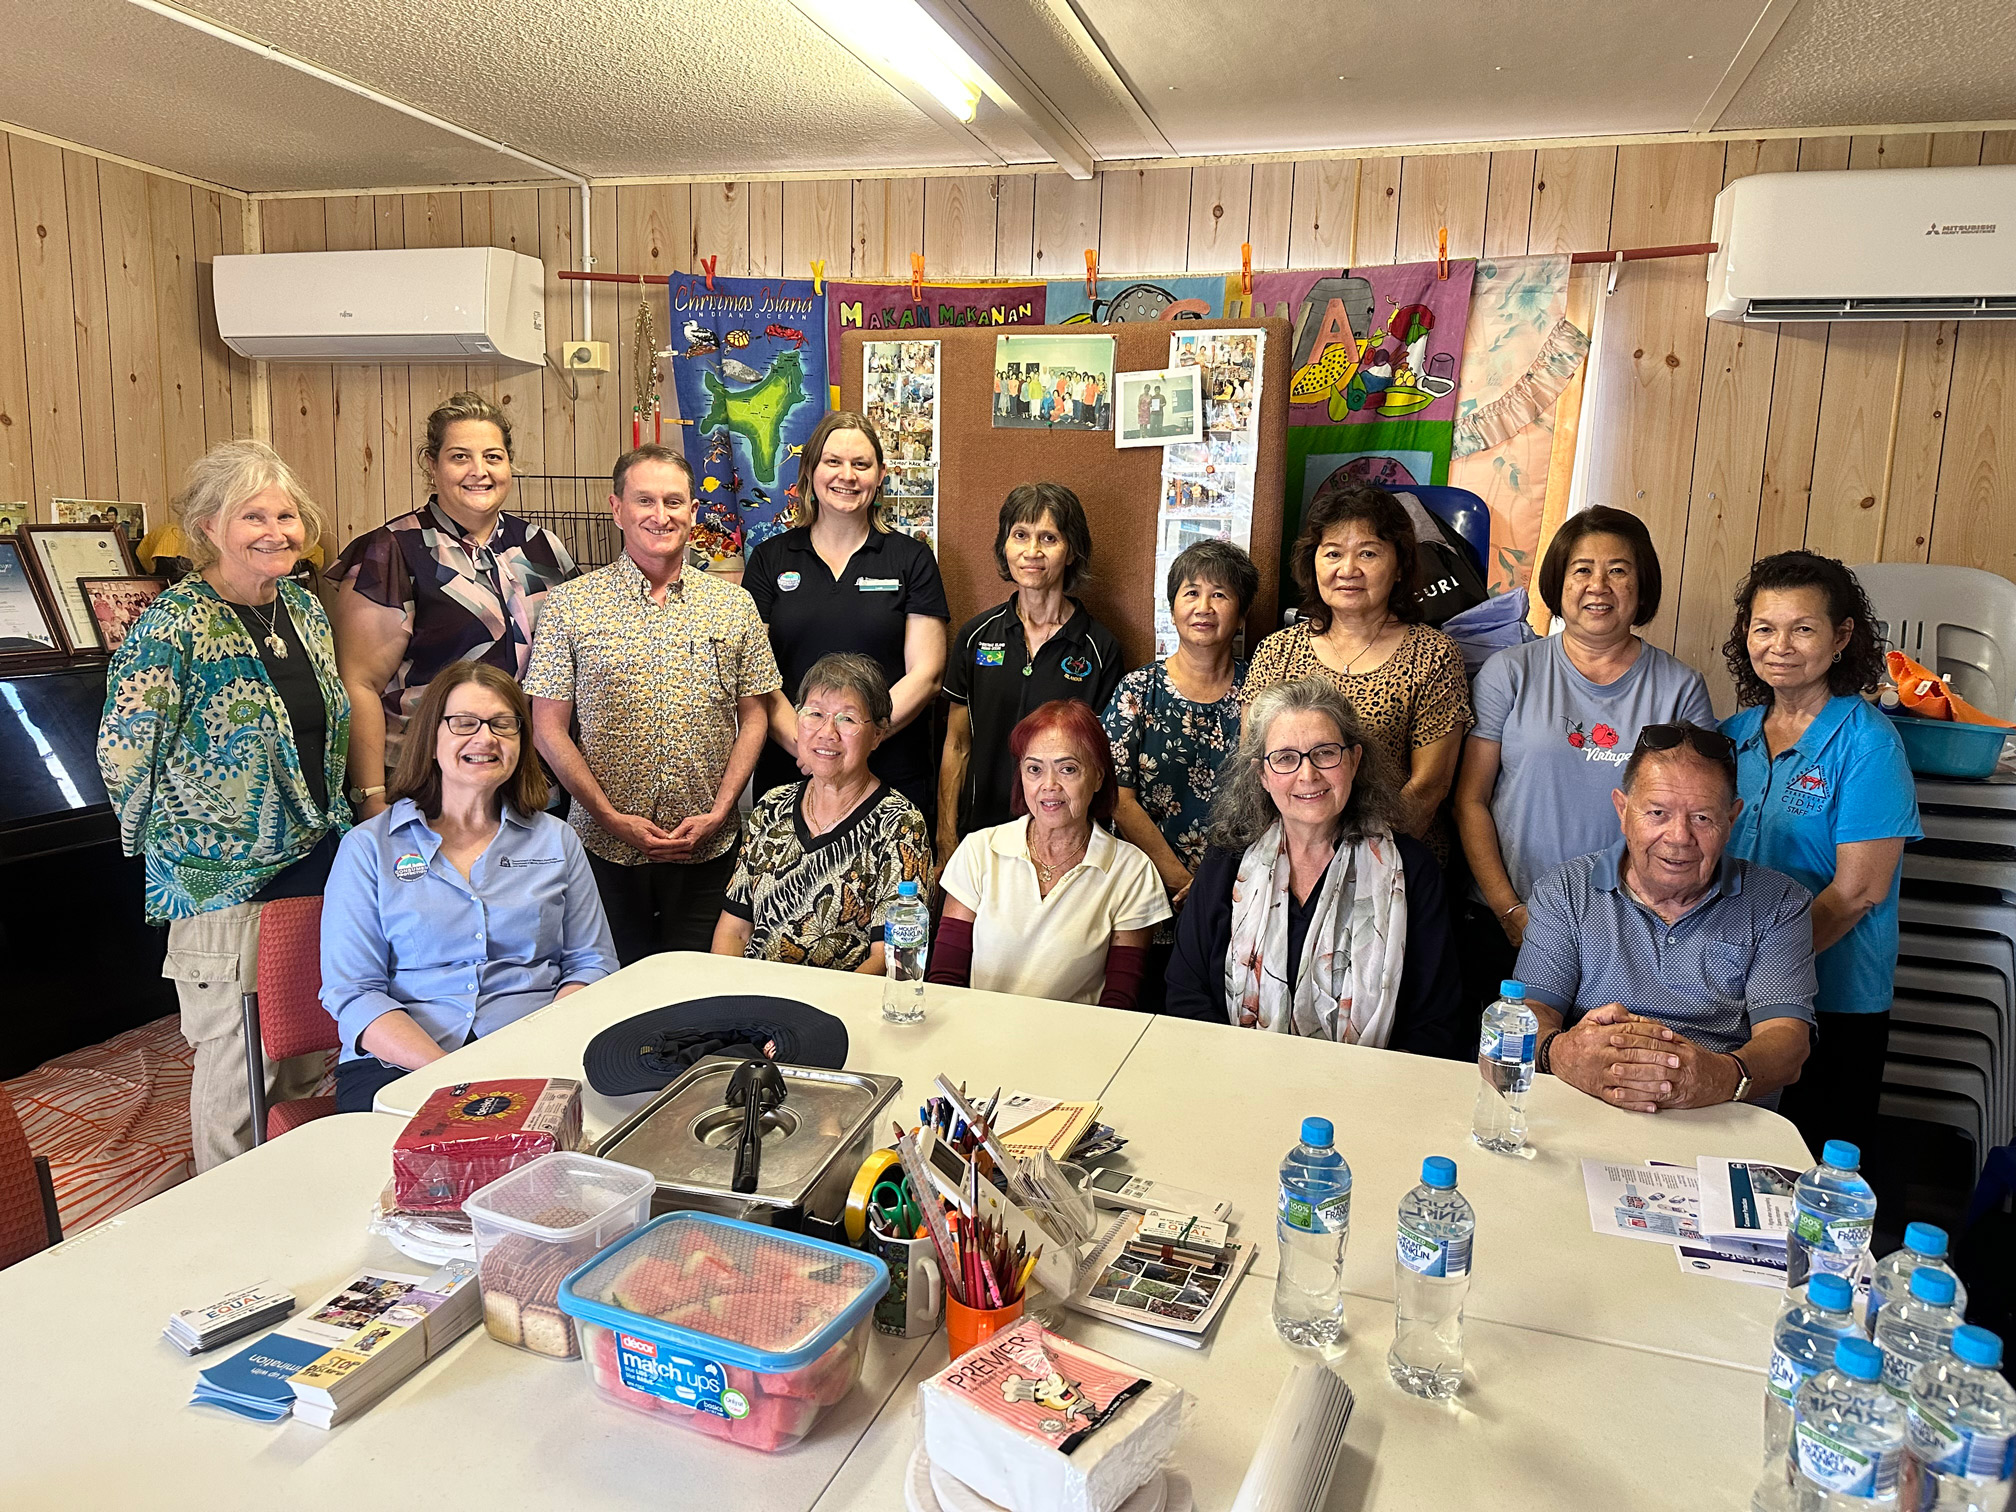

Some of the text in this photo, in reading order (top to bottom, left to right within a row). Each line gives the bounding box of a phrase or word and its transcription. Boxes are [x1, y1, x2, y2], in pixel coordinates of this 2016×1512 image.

[674, 280, 815, 313] Christmas Island
[689, 311, 807, 321] INDIAN OCEAN
[840, 300, 1032, 329] MAKAN MAKANAN
[1581, 747, 1632, 767] Vintage
[1781, 795, 1823, 813] CIDHS
[1786, 805, 1808, 816] STAFF
[893, 929, 922, 937] FRANKLIN
[1290, 1202, 1309, 1213] 100%
[1800, 1214, 1820, 1229] 100%
[206, 1294, 266, 1319] EQUAL
[623, 1335, 656, 1354] décor
[321, 1356, 361, 1371] STOP
[947, 1336, 1033, 1389] PREMIER
[623, 1352, 721, 1393] match ups
[703, 1400, 724, 1412] basics
[1801, 1437, 1857, 1476] FRANKLIN
[1810, 1440, 1845, 1463] MOUNT
